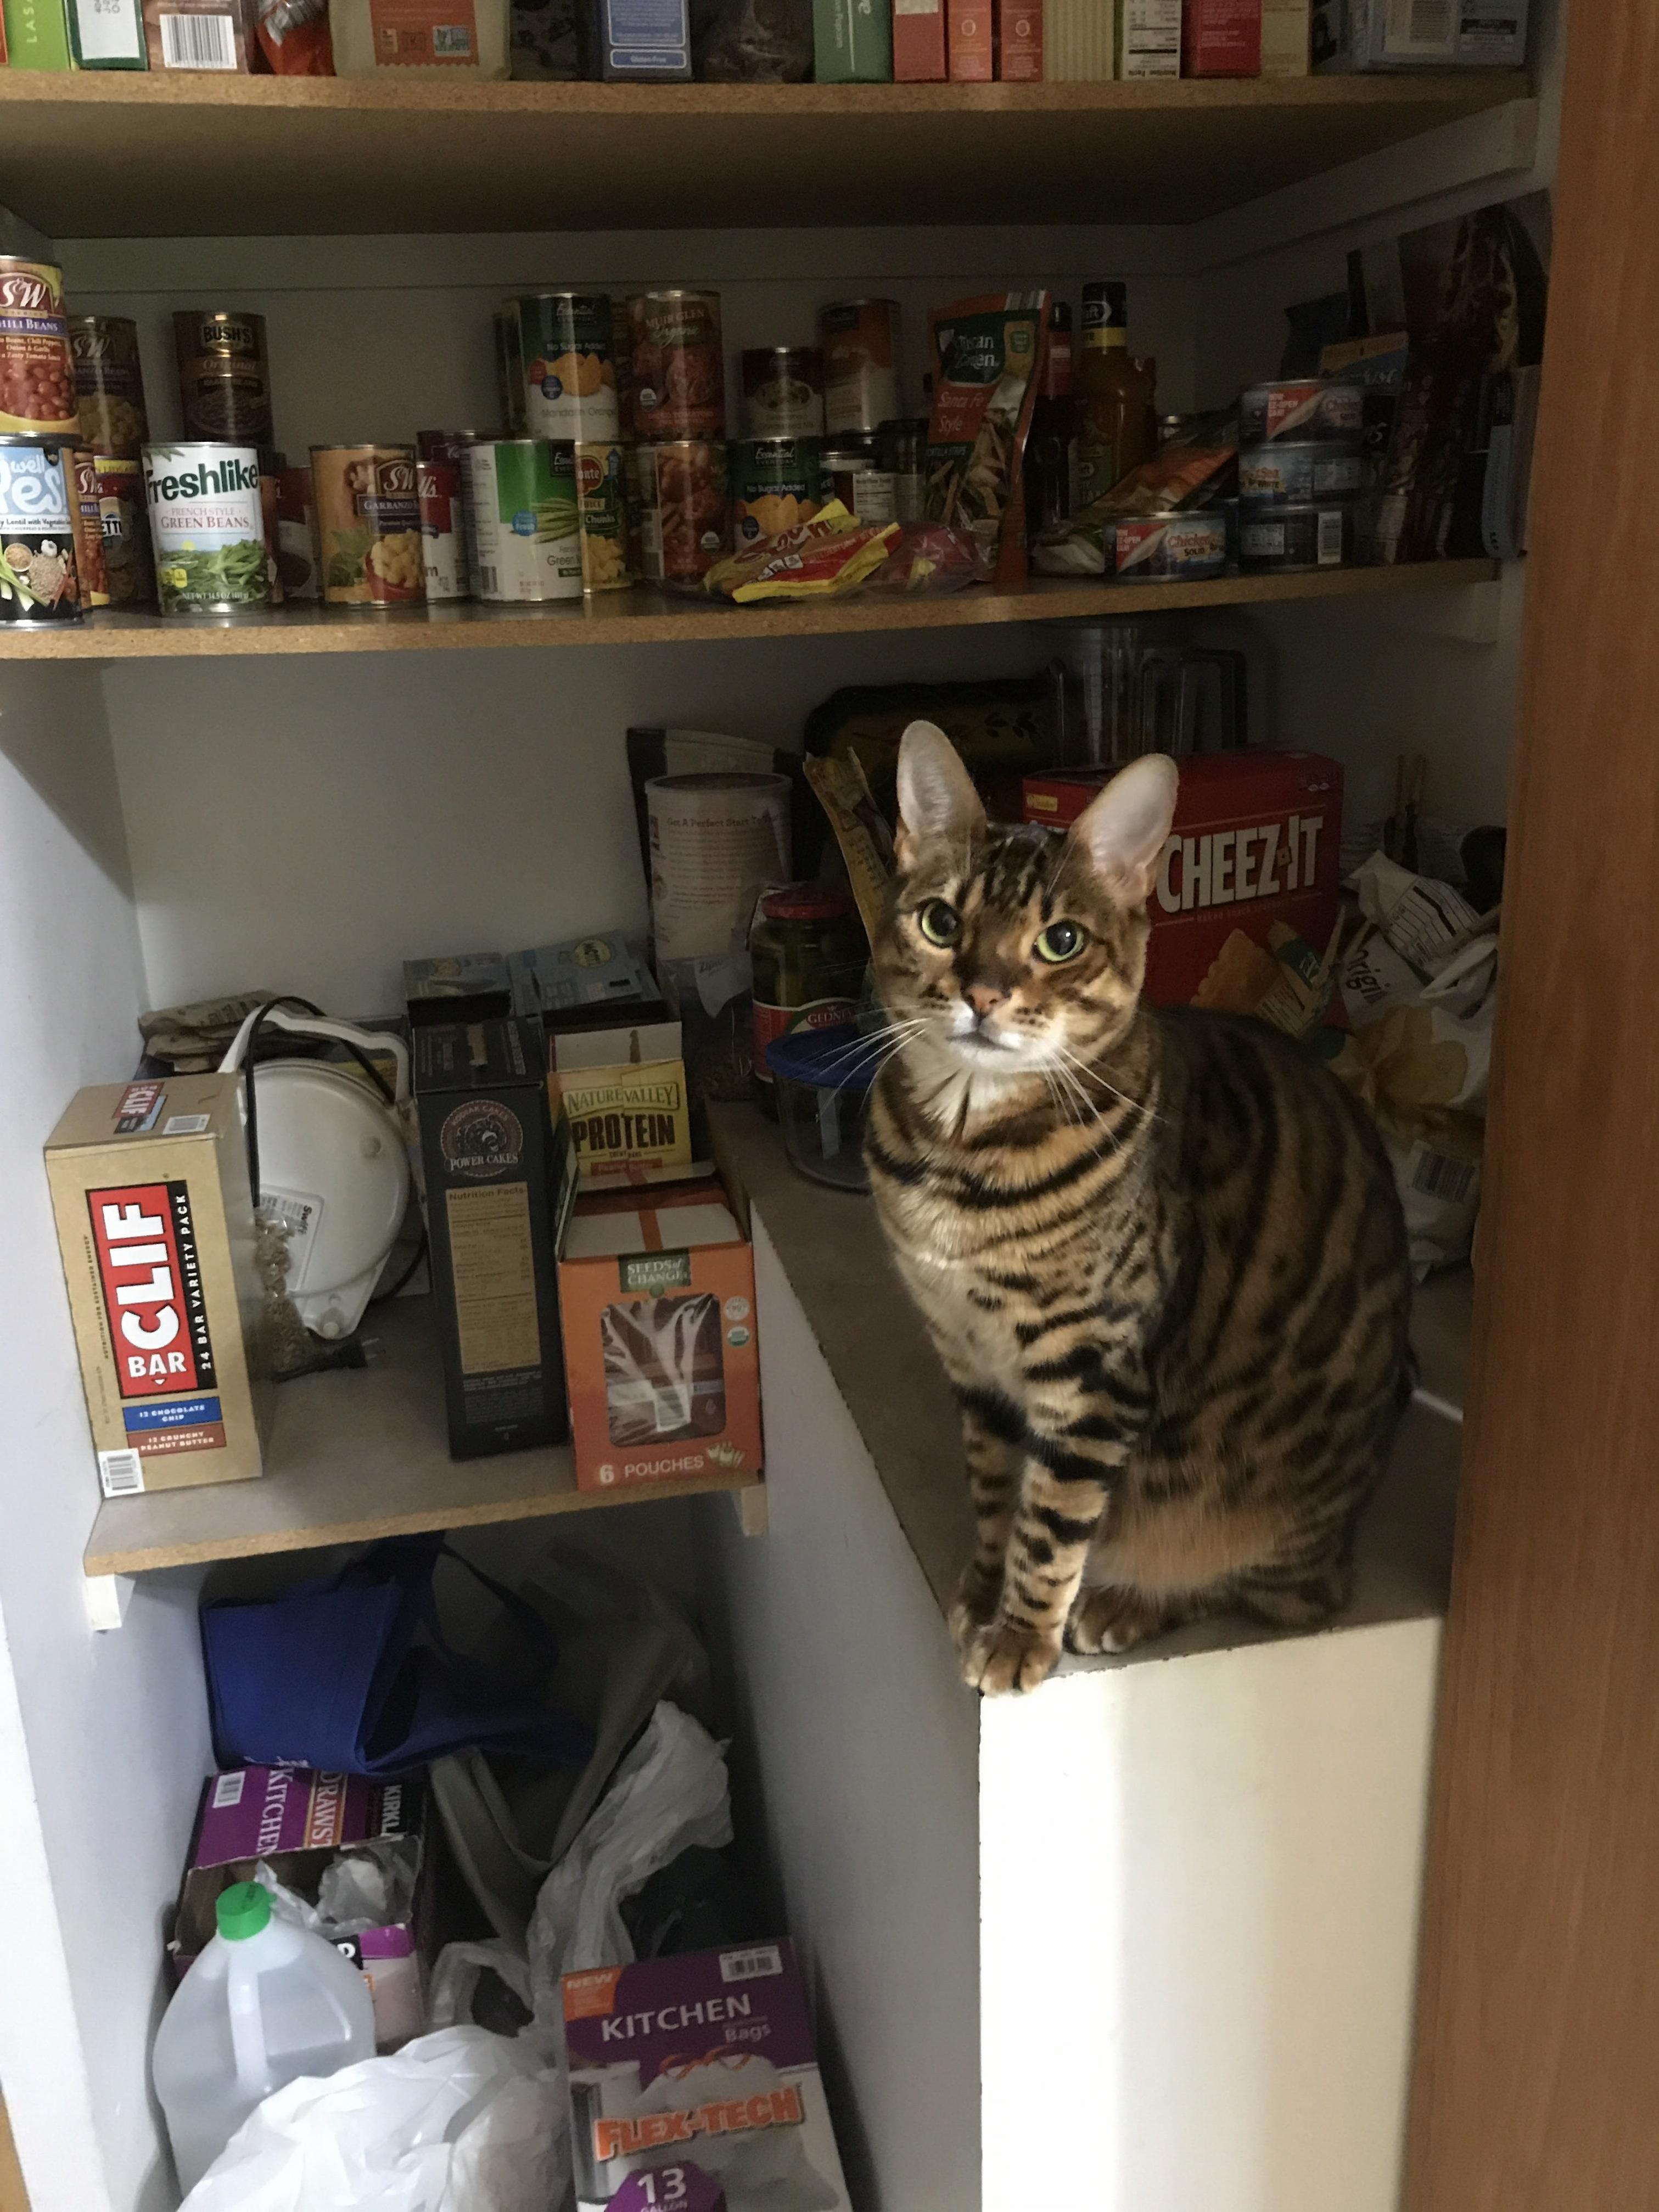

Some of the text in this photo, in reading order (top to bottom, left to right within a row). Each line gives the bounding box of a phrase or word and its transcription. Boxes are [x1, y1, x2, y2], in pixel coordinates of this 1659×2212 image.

[0, 318, 57, 331] HILI BEANS
[202, 358, 256, 372] Oriinal
[542, 408, 585, 418] Mandan
[578, 469, 599, 479] onte
[781, 484, 805, 492] Added
[171, 507, 234, 515] FRENCH STYLE
[161, 516, 249, 529] GREEN BEANS
[568, 1085, 673, 1114] NATURE VALLEY
[571, 1113, 675, 1153] PROTEIN
[450, 1152, 519, 1172] POWER CAKES
[448, 1186, 525, 1202] Nutrition Facts
[627, 1260, 672, 1274] SEEDS
[102, 1203, 180, 1350] CLIF
[176, 1195, 212, 1371] 24 BAR VARIETY PACK
[128, 1351, 187, 1378] BAR
[151, 1404, 205, 1417] CHOCOLATE
[140, 1436, 215, 1451] PEANUT BUTTER
[160, 1431, 205, 1441] CRUNCHY
[599, 1455, 704, 1484] 6 POUCHES
[567, 1973, 613, 1989] NEW
[602, 1993, 752, 2042] KITCHEN
[593, 2086, 803, 2162] FLEX-TECH
[637, 2168, 687, 2204] 13
